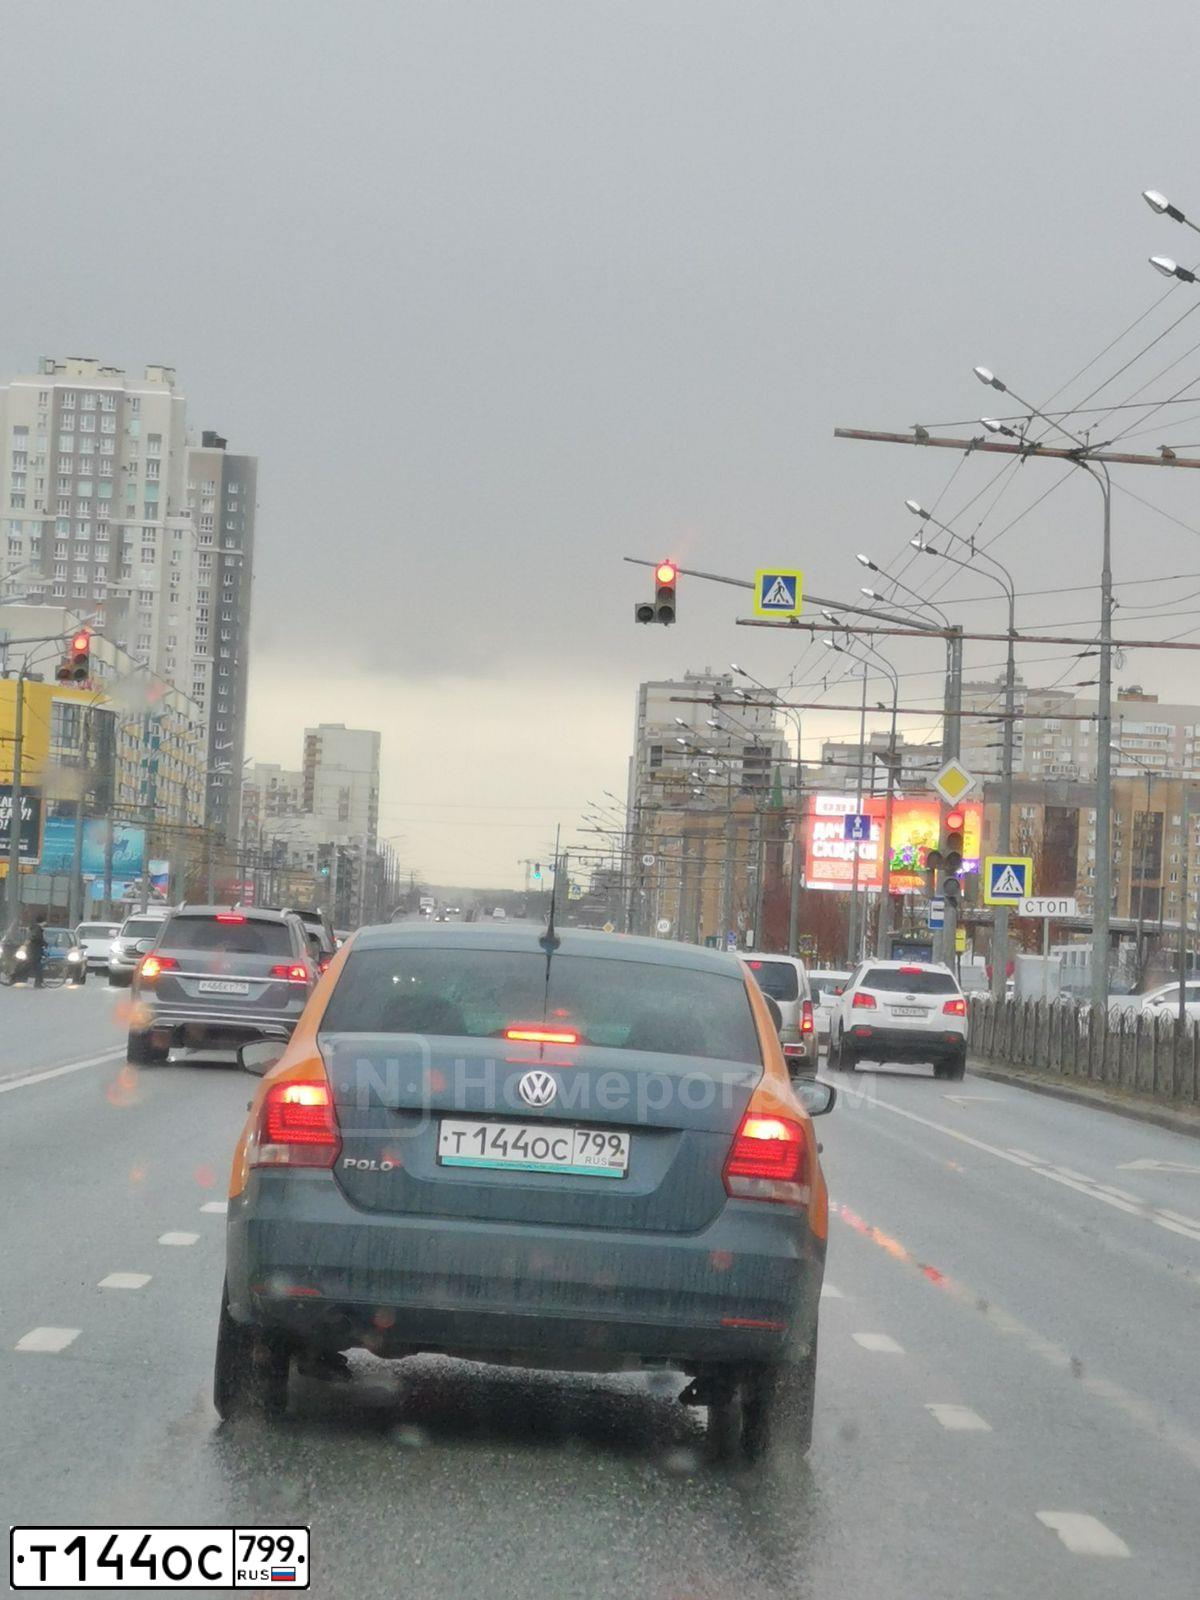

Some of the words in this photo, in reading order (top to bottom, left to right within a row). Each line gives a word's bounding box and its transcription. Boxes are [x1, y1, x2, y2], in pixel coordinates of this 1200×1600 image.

[1025, 901, 1068, 913] СТОП
[577, 1132, 622, 1157] 799
[343, 1158, 394, 1171] POLO
[585, 1156, 608, 1166] RUS
